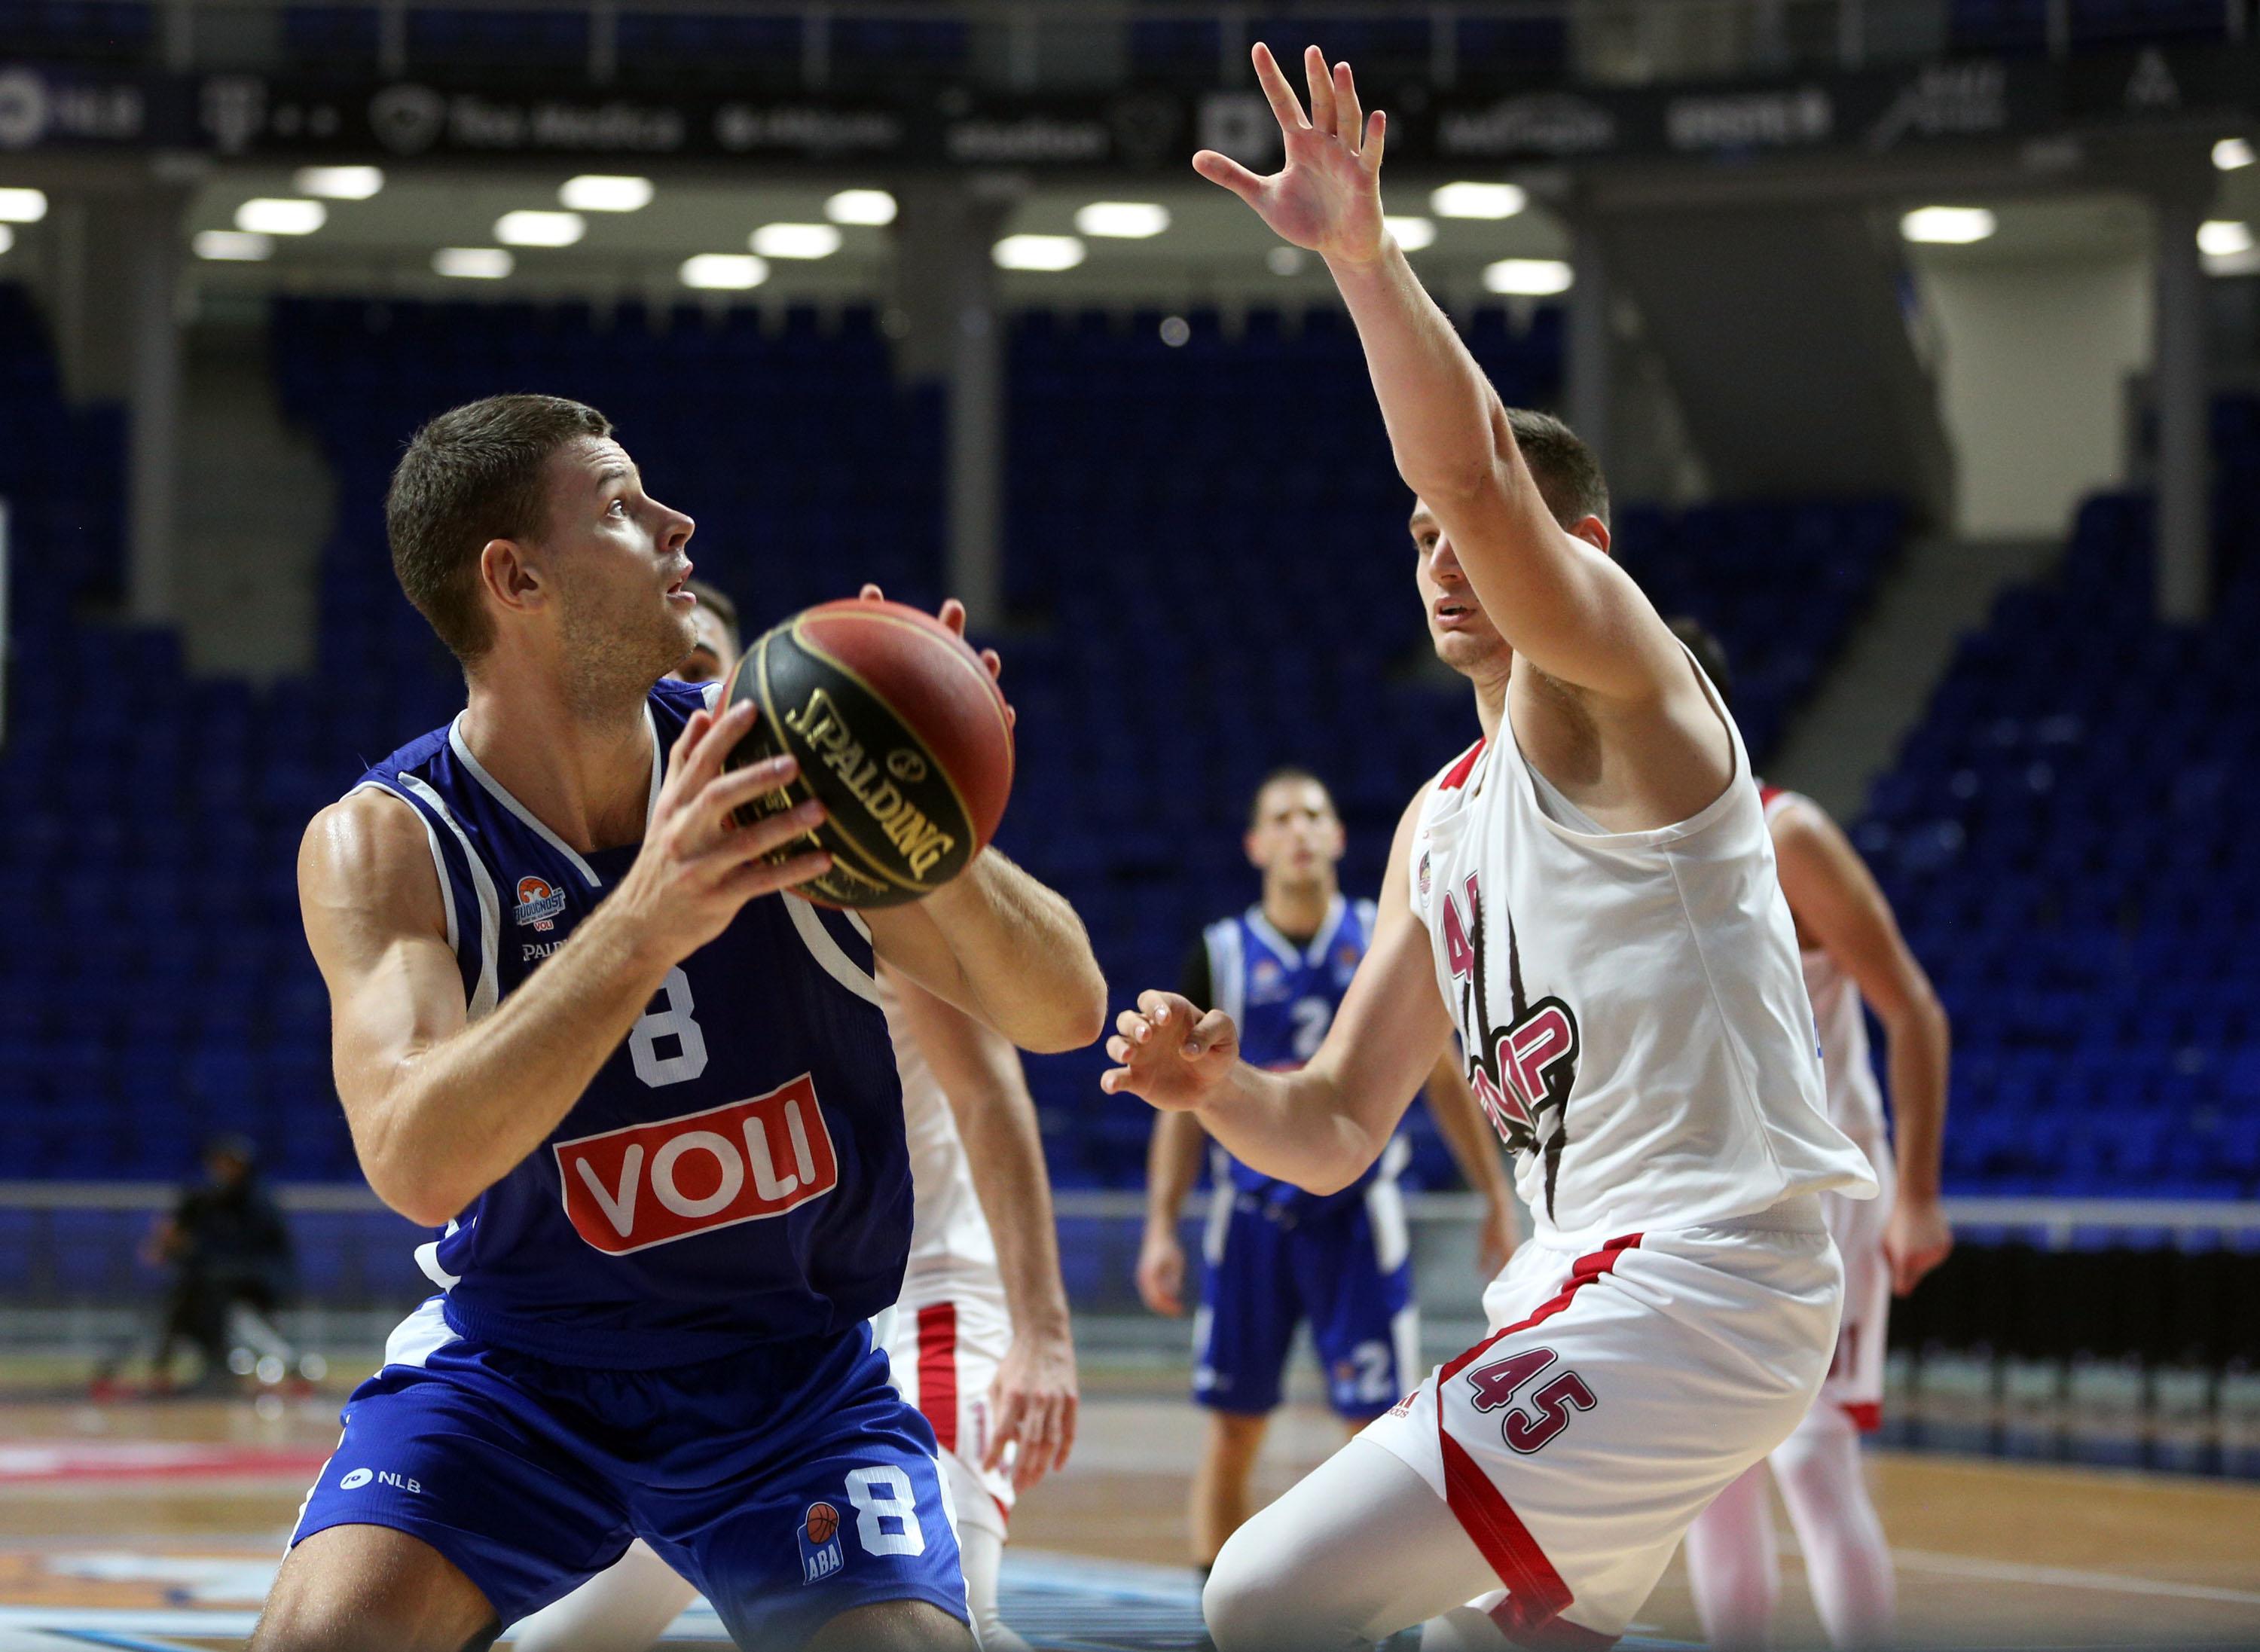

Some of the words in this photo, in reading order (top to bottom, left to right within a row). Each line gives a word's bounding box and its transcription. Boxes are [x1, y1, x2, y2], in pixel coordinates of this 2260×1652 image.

[786, 687, 954, 880] SPALDING
[1442, 869, 1478, 984] 4
[628, 964, 709, 1089] 8
[575, 1099, 816, 1238] VOLI
[1467, 1346, 1598, 1454] 45
[378, 1470, 422, 1494] NLB
[844, 1464, 926, 1557] 8
[808, 1544, 840, 1581] ABA
